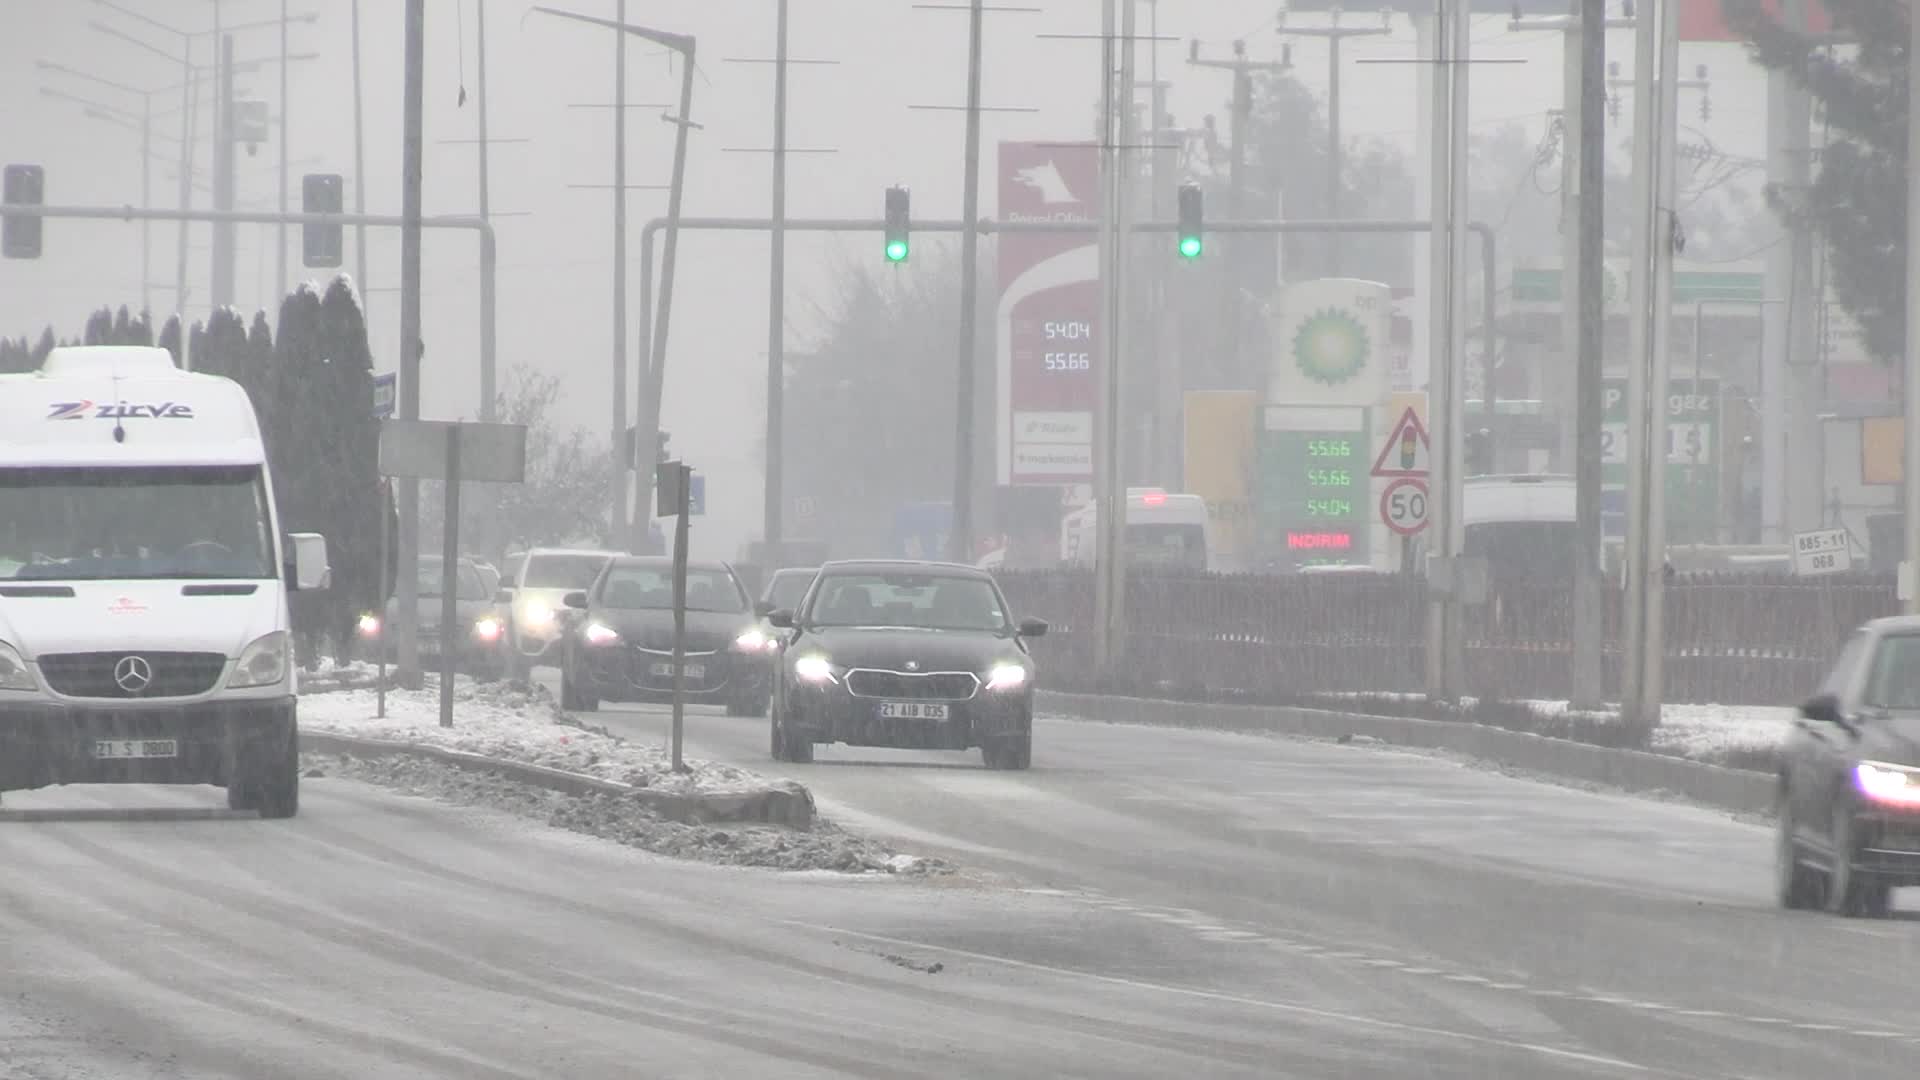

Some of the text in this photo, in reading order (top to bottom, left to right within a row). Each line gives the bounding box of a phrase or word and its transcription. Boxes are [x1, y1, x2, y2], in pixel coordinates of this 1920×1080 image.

[1045, 321, 1090, 338] 54.04
[1045, 352, 1090, 370] 55.66
[96, 400, 193, 418] zirve
[1392, 494, 1425, 519] 50
[881, 704, 895, 716] 21
